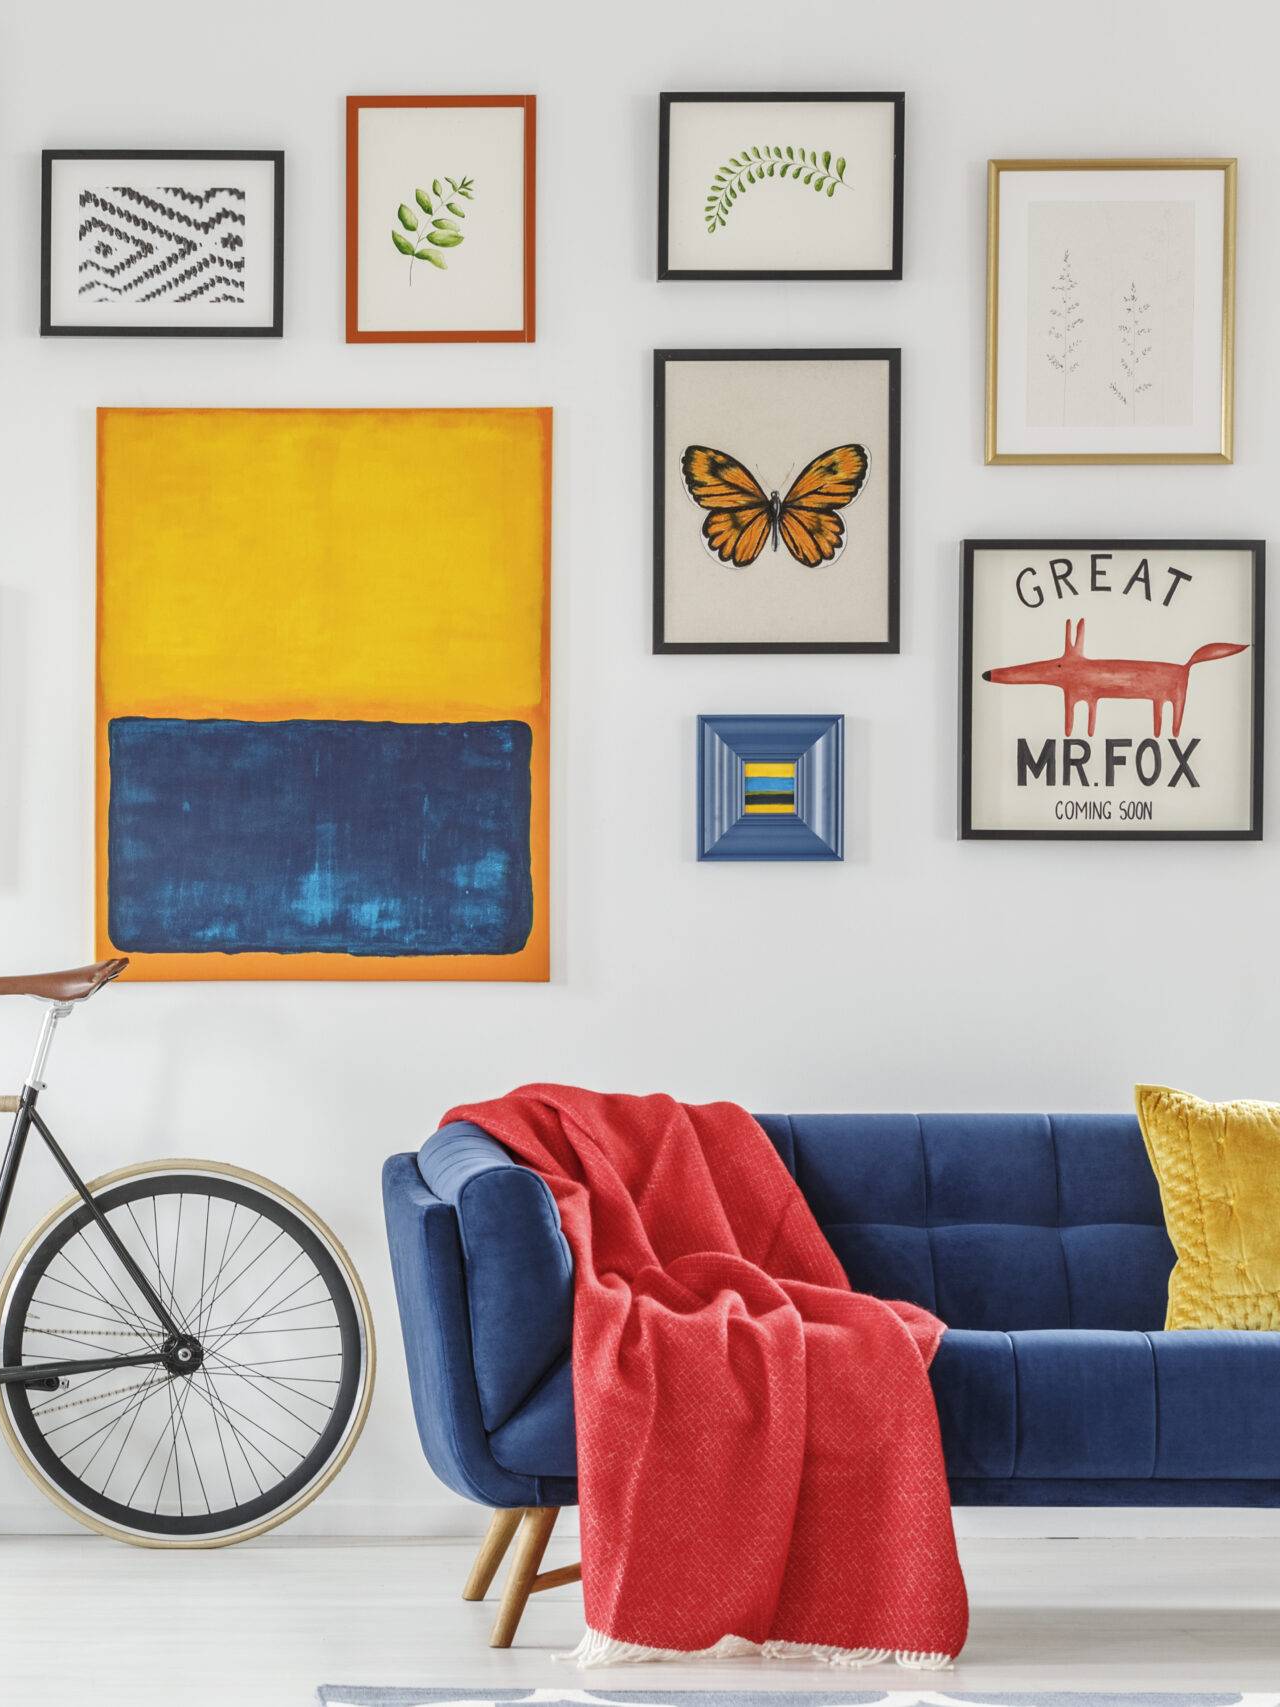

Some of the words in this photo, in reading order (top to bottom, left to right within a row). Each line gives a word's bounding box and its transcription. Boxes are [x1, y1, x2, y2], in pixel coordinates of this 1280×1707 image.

[1016, 554, 1192, 608] GREAT
[1055, 800, 1112, 820] COMING
[1119, 800, 1153, 820] SOON
